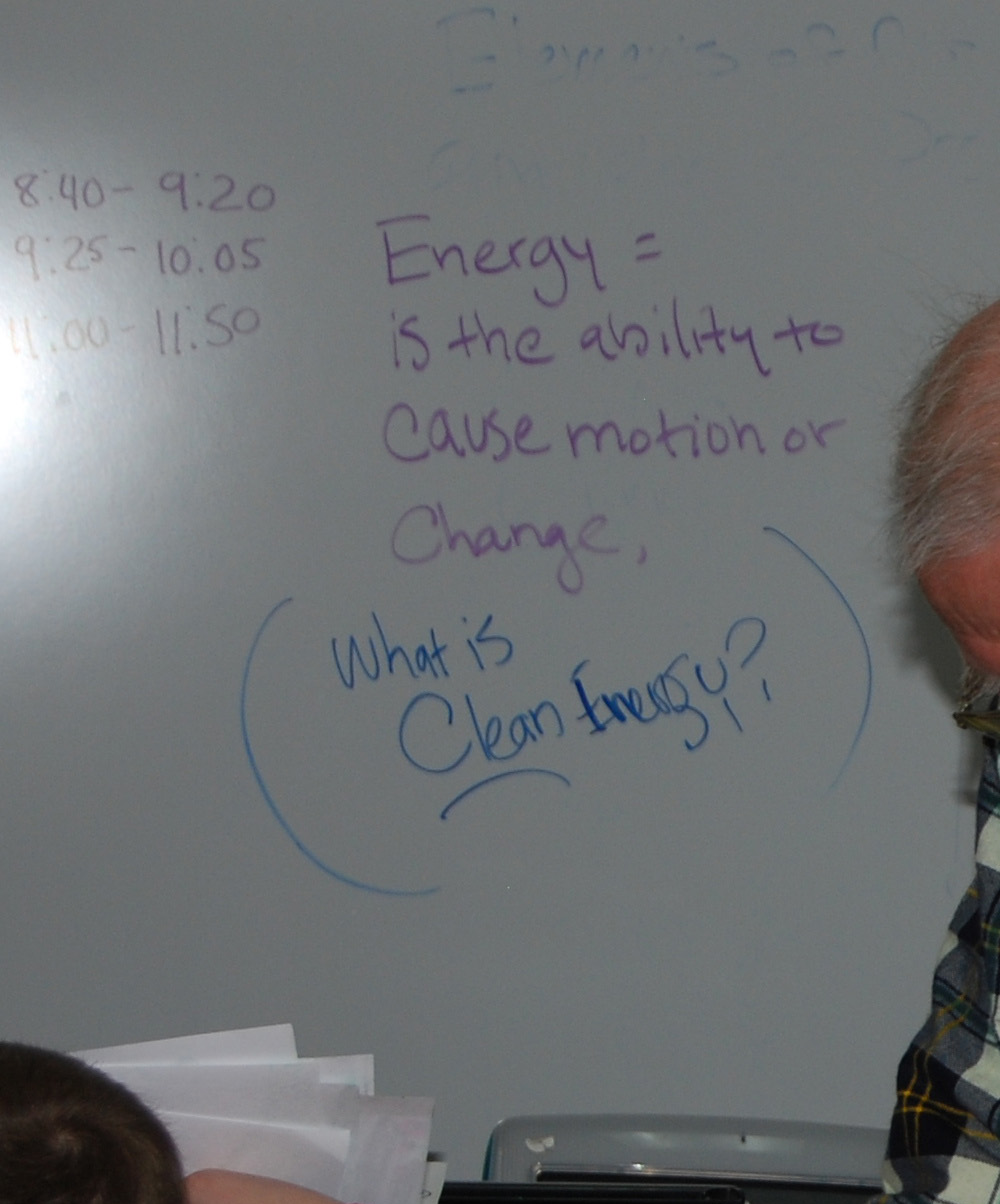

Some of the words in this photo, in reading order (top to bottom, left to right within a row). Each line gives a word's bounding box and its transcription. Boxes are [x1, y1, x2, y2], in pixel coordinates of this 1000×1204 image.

[375, 213, 607, 308] Energy
[391, 306, 431, 372] is
[447, 308, 556, 365] the
[579, 296, 772, 378] ability
[772, 313, 846, 354] to
[564, 407, 768, 461] motion
[782, 417, 848, 456] or
[331, 610, 453, 691] What
[461, 613, 515, 671] is
[398, 690, 566, 774] Clean
